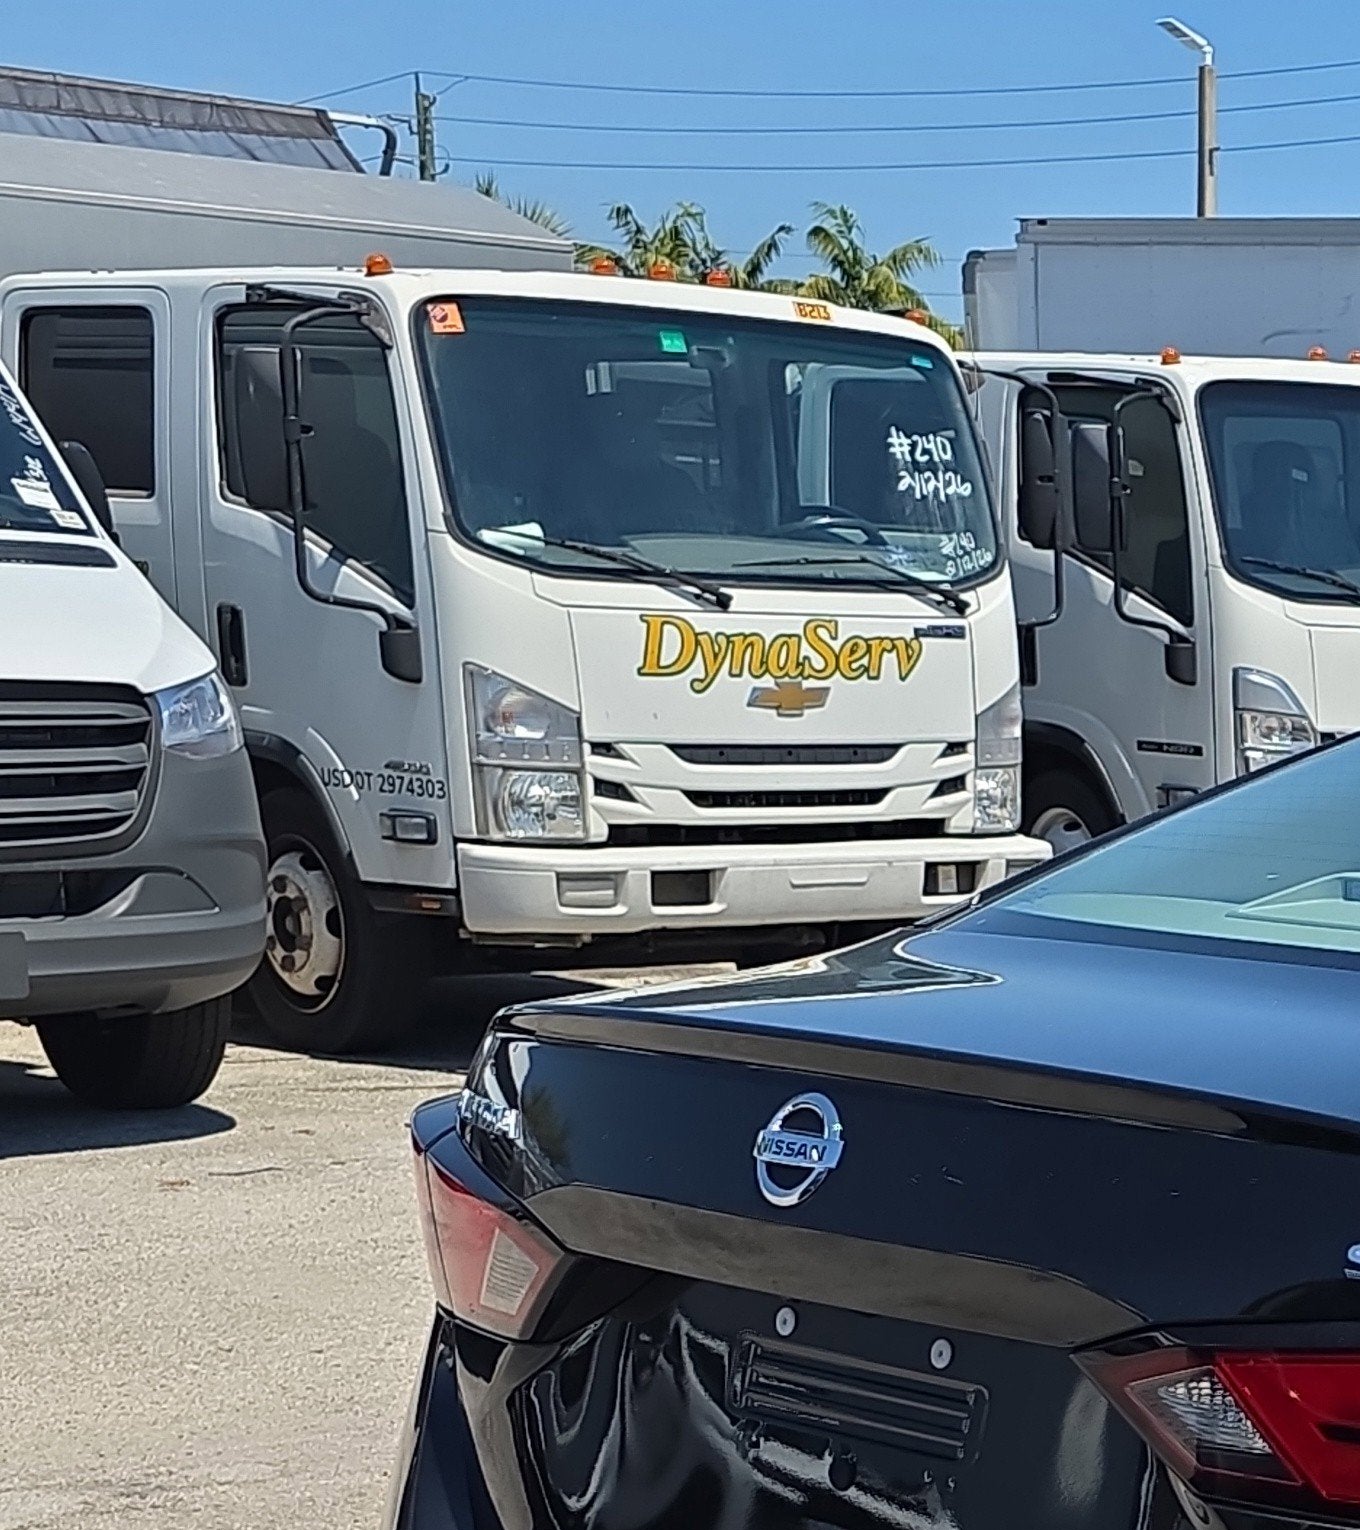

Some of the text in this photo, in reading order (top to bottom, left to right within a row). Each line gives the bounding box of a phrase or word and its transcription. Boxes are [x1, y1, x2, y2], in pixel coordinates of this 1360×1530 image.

[886, 425, 953, 462] #240
[897, 470, 972, 502] 2/12/26
[638, 614, 923, 694] DynaServ
[322, 766, 374, 792] USDOT
[376, 773, 447, 800] 2974303
[757, 1136, 828, 1162] NISSAN
